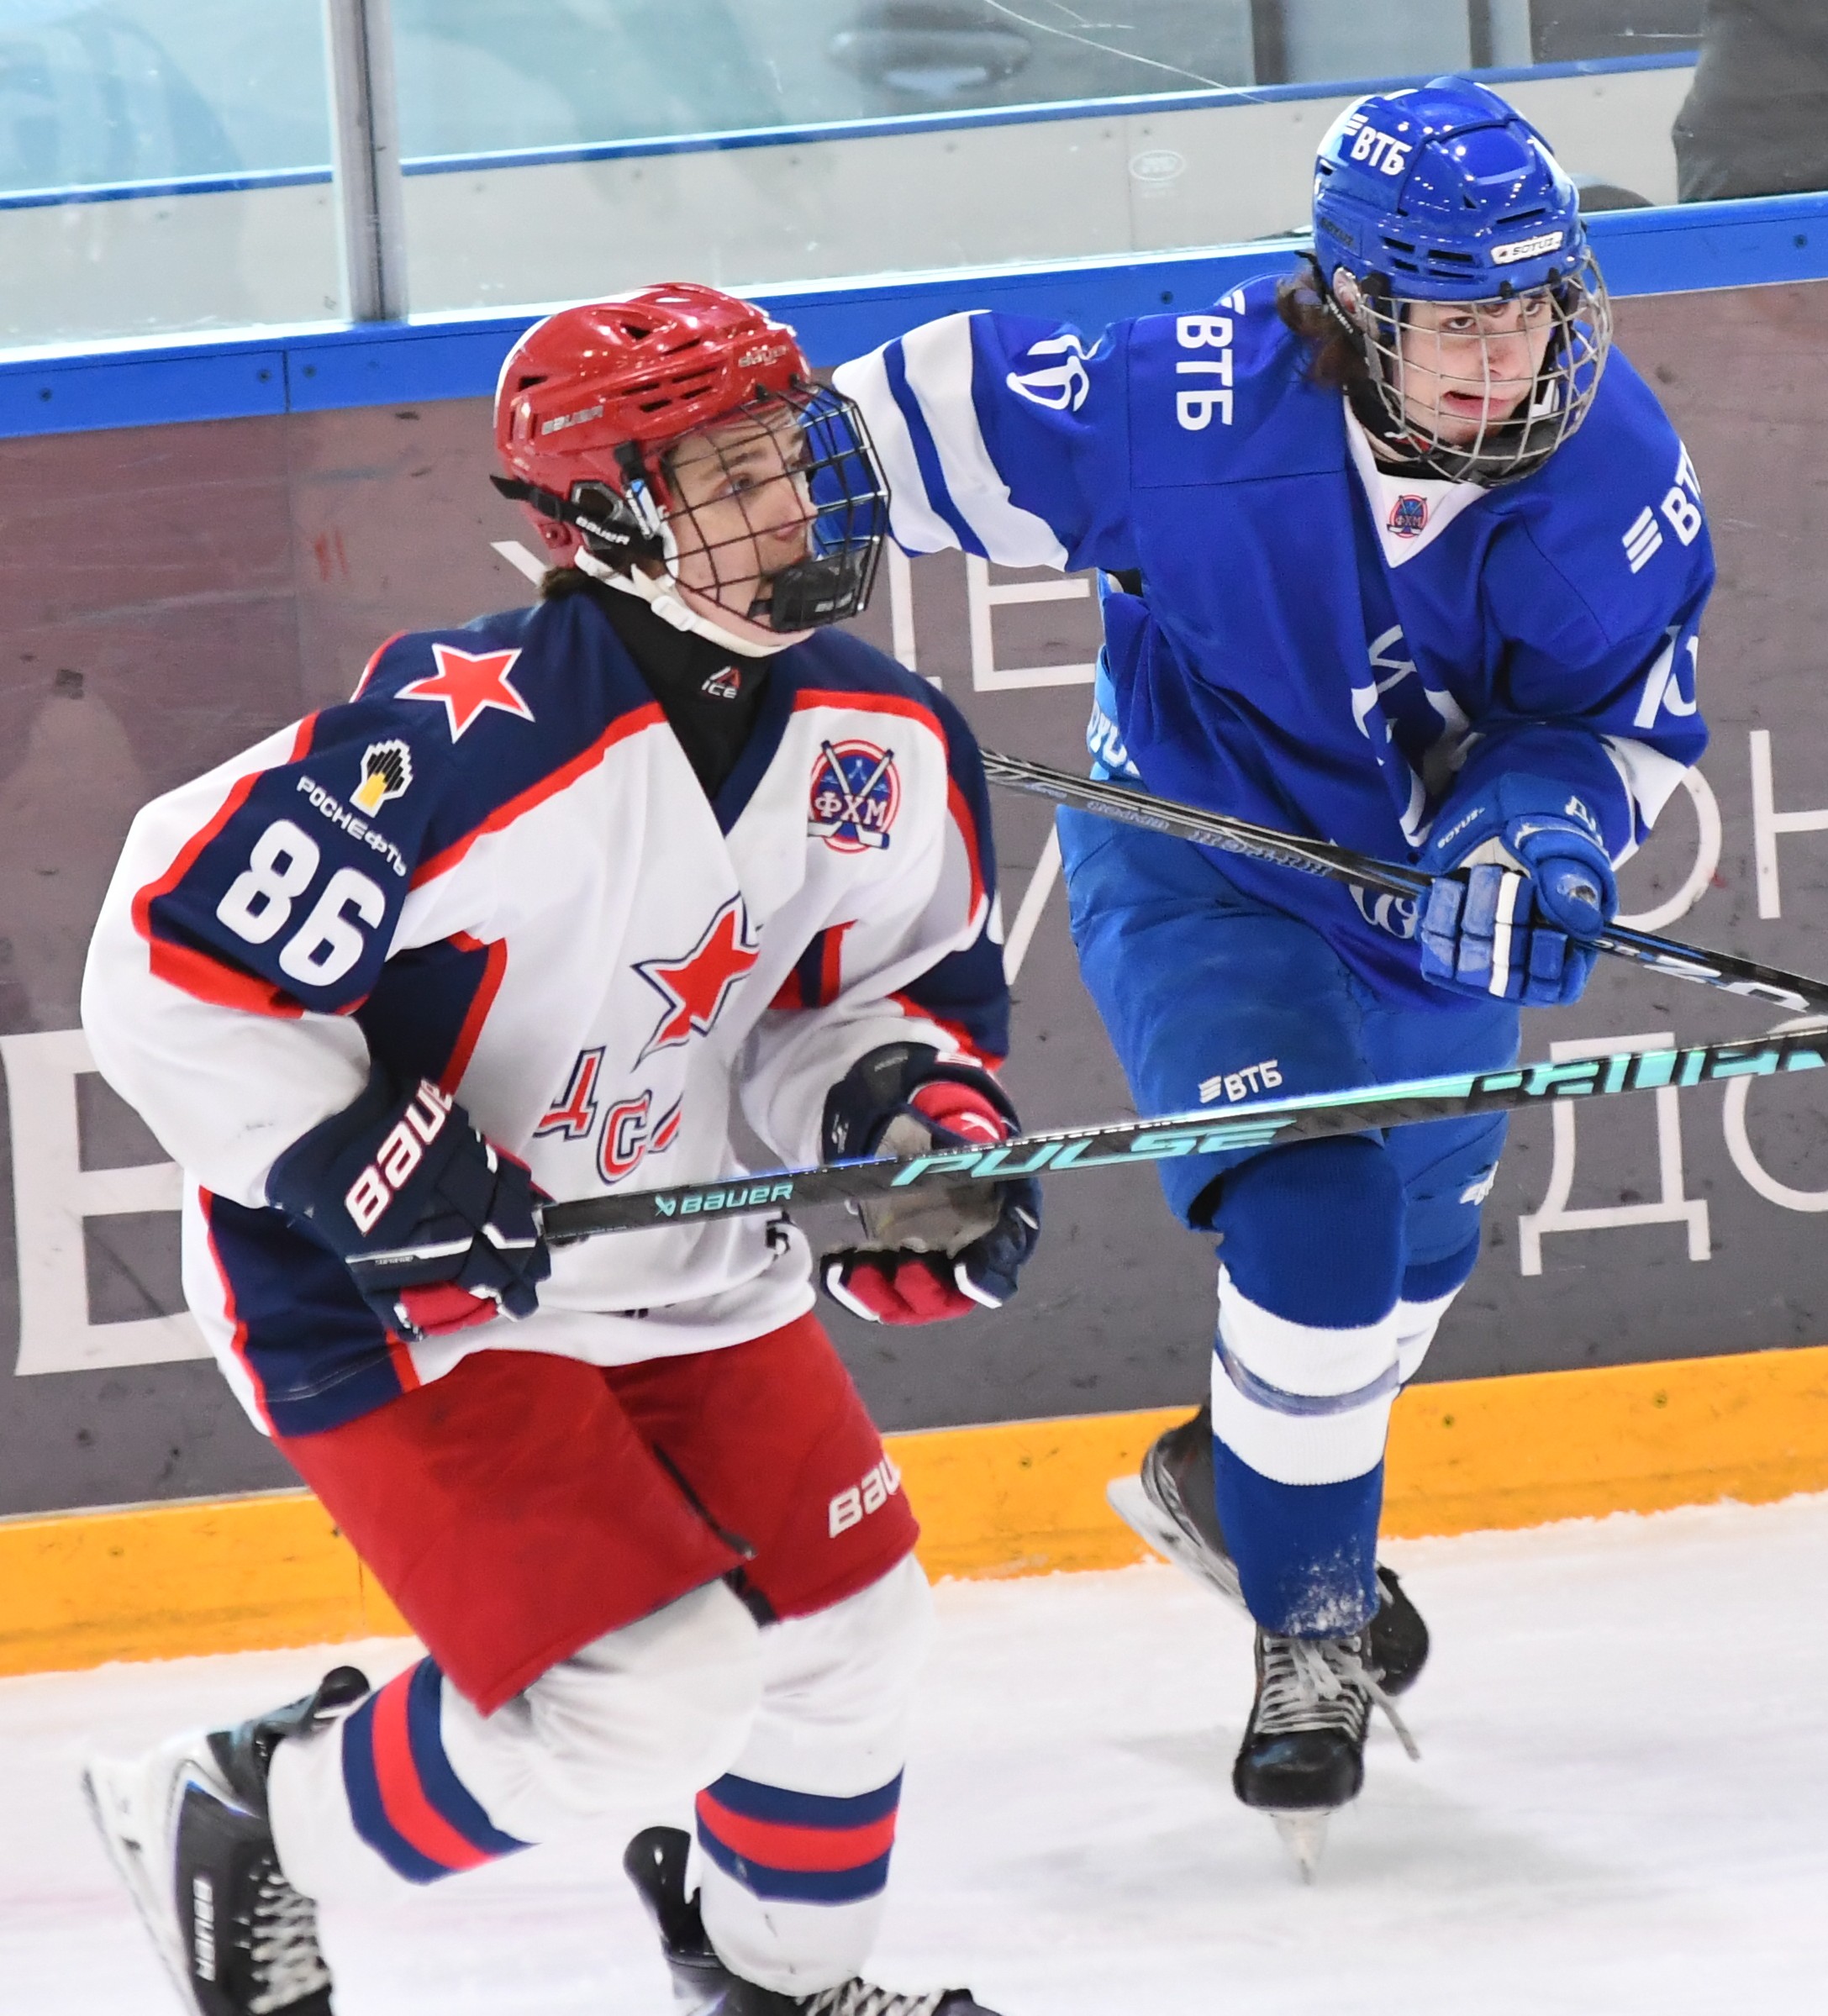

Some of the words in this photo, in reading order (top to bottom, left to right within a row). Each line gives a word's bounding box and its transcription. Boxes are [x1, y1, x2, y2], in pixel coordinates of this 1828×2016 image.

[1350, 126, 1413, 176] ВТБ
[1176, 315, 1233, 431] ВТБ
[1661, 440, 1702, 546] ВТ
[701, 679, 737, 699] ICE
[296, 775, 408, 877] РОСНЕФТЬ
[814, 791, 888, 828] ФХМ
[216, 818, 386, 987] 86
[1223, 1059, 1283, 1102] ВТБ
[890, 1119, 1298, 1187] PULSE
[680, 1182, 793, 1215] BAUER
